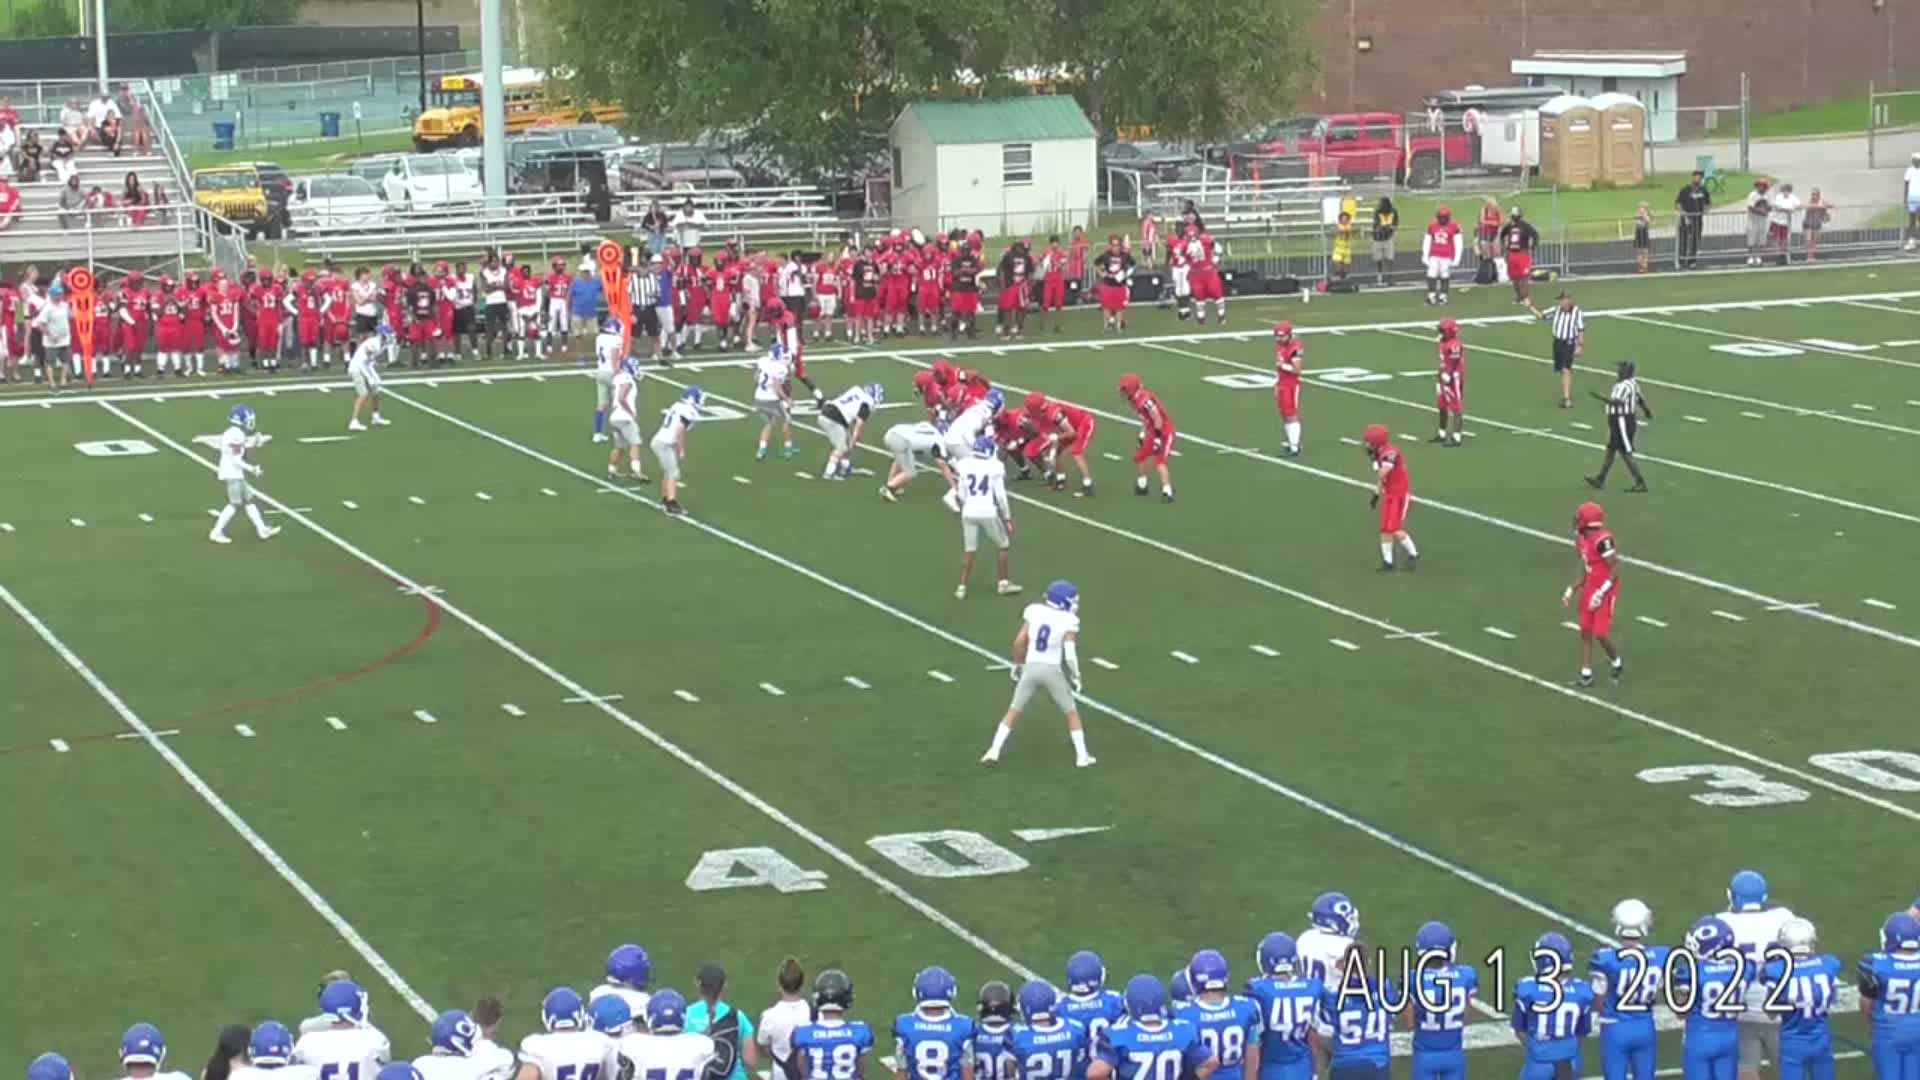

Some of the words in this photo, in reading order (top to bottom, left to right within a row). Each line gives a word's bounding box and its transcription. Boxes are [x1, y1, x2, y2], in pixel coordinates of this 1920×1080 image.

[967, 474, 990, 496] 24
[1035, 624, 1052, 652] 8
[1702, 981, 1745, 1018] 8
[1270, 997, 1316, 1042] 45
[1339, 1008, 1387, 1044] 54
[808, 1044, 857, 1080] 18
[915, 1040, 949, 1080] 8
[1128, 1049, 1183, 1080] 70
